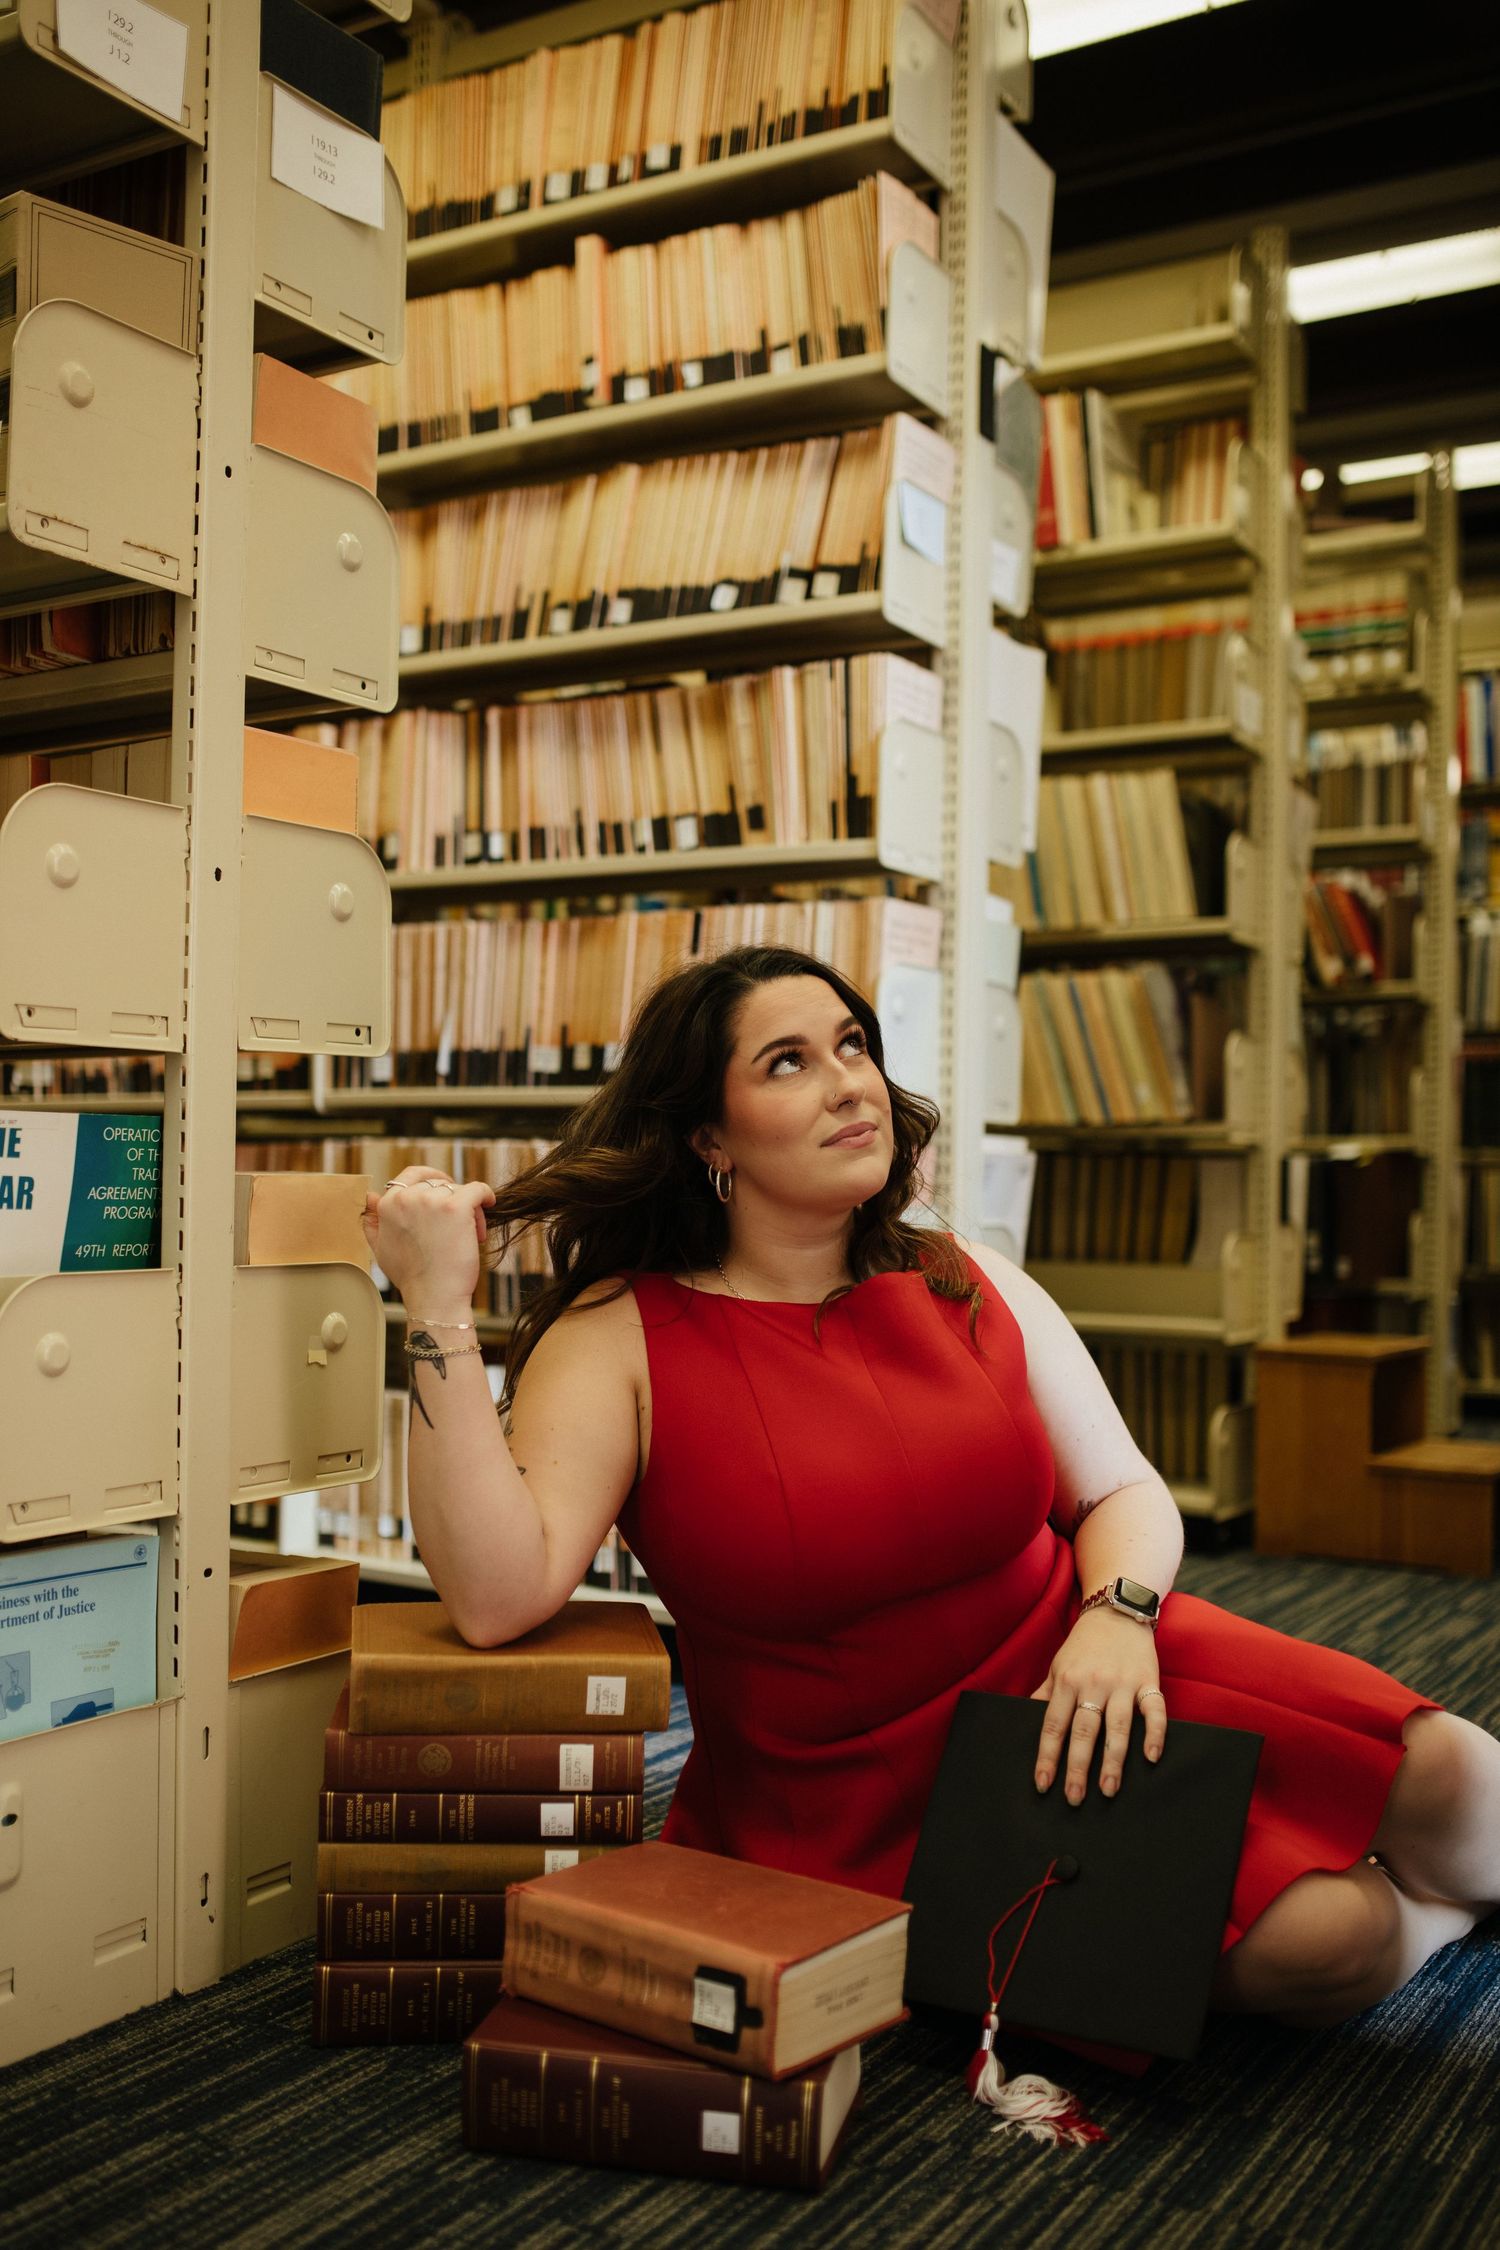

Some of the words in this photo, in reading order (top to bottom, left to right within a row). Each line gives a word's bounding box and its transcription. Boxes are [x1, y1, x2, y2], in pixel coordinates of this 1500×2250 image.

[113, 13, 134, 34] 29.2
[109, 44, 114, 55] J
[316, 137, 338, 157] 19.13
[318, 168, 336, 185] 29.2
[103, 1127, 161, 1142] OPERATIO
[127, 1147, 144, 1161] OF
[132, 1167, 160, 1181] TRAD
[75, 1244, 106, 1258] 49TH
[112, 1244, 155, 1257] REPORT
[34, 1587, 58, 1603] with
[61, 1585, 79, 1599] the
[43, 1605, 55, 1621] of
[57, 1601, 96, 1619] Justice
